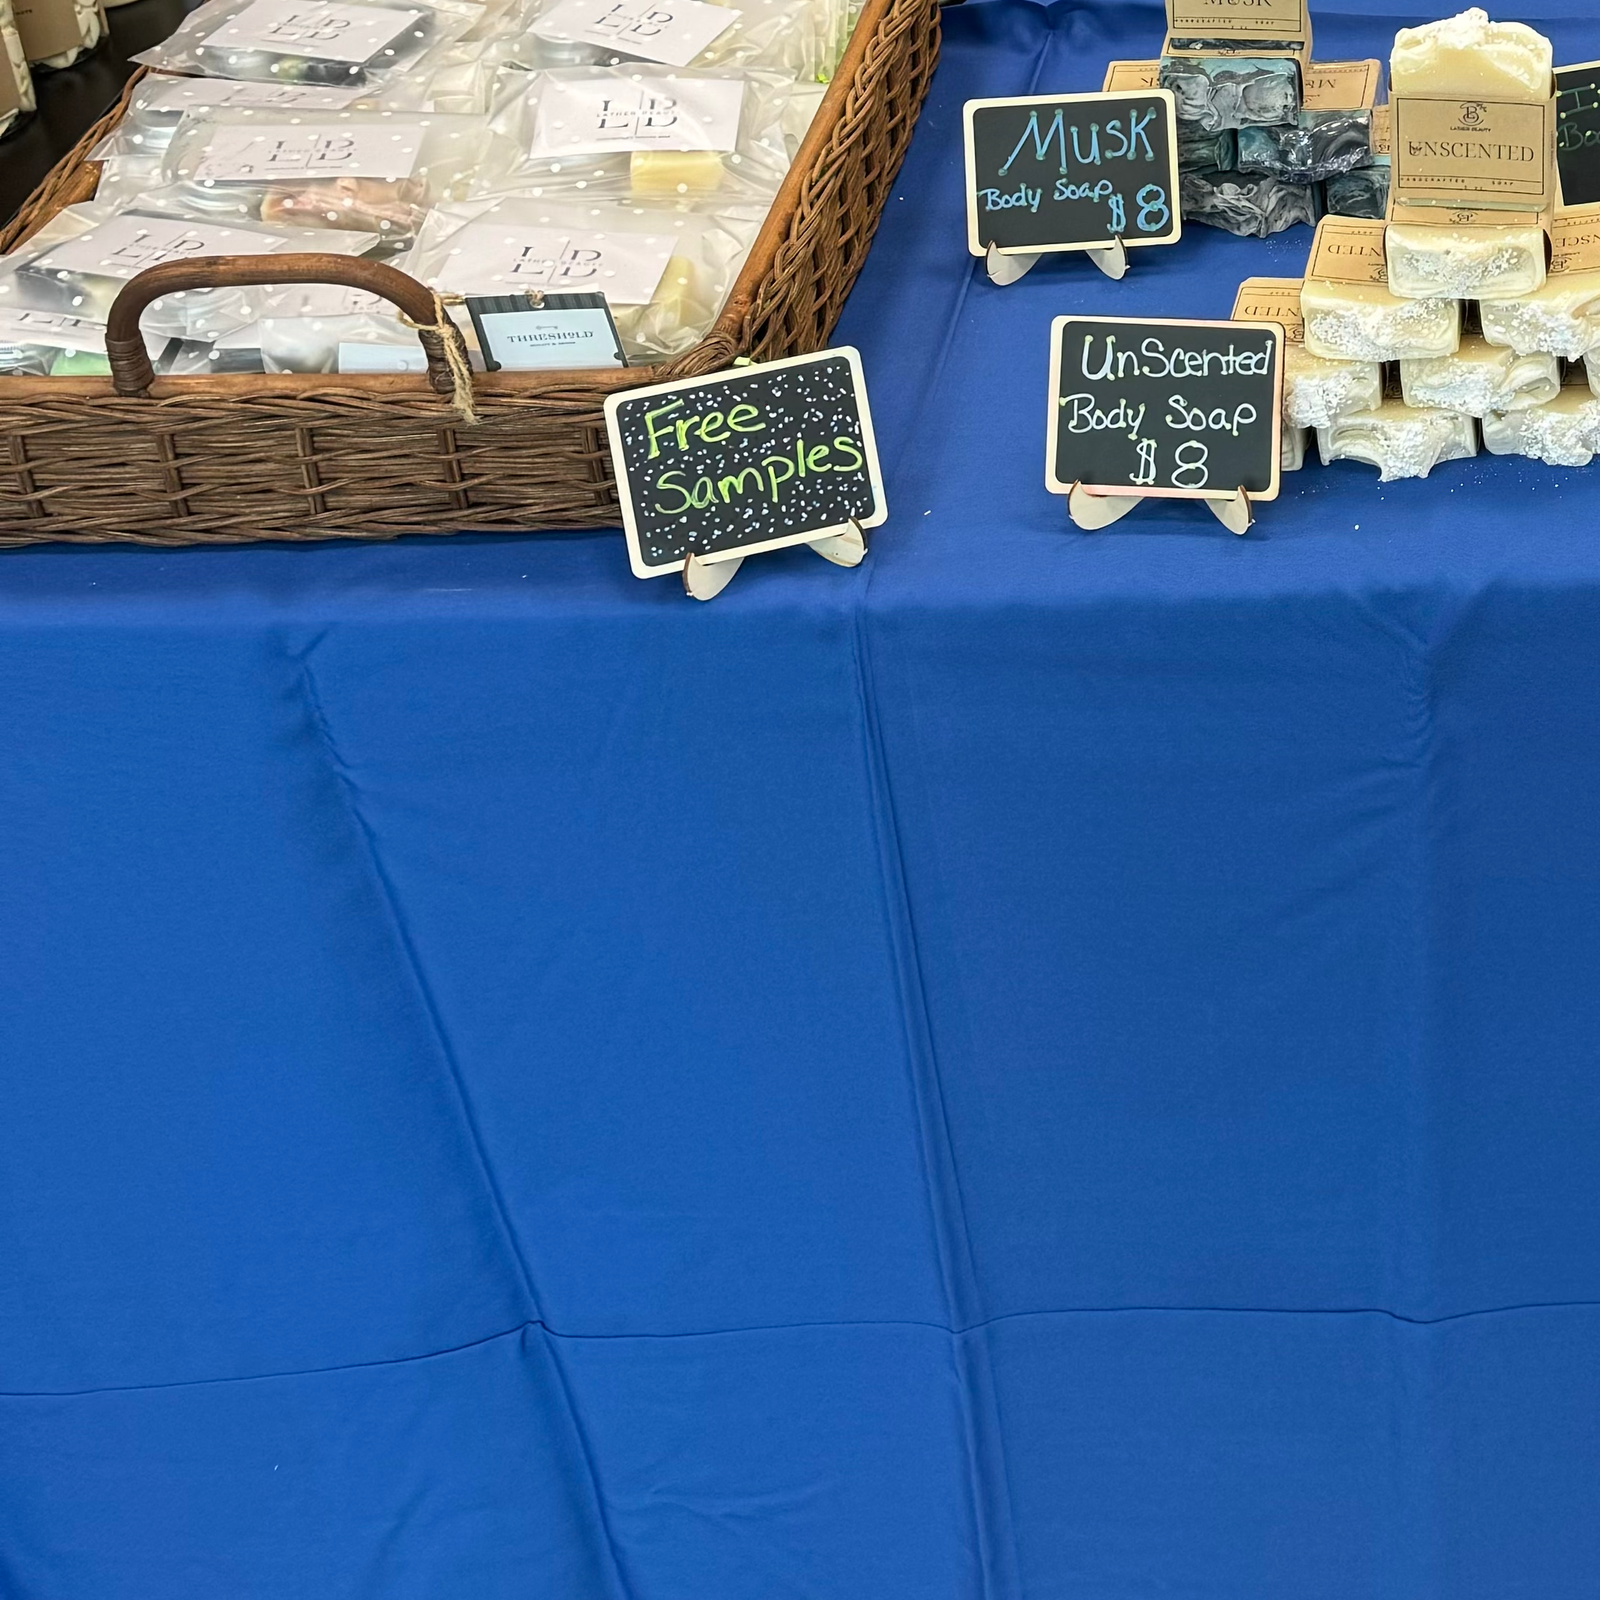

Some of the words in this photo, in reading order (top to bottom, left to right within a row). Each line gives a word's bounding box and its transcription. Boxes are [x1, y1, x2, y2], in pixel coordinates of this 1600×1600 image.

[1408, 140, 1535, 163] UNSCENTED
[977, 183, 1043, 213] Body
[1107, 183, 1170, 233] $8
[507, 330, 595, 343] THRESHOLD
[644, 398, 767, 460] Free
[1059, 394, 1146, 440] Body
[654, 436, 863, 514] Samples
[1129, 438, 1209, 489] $8
